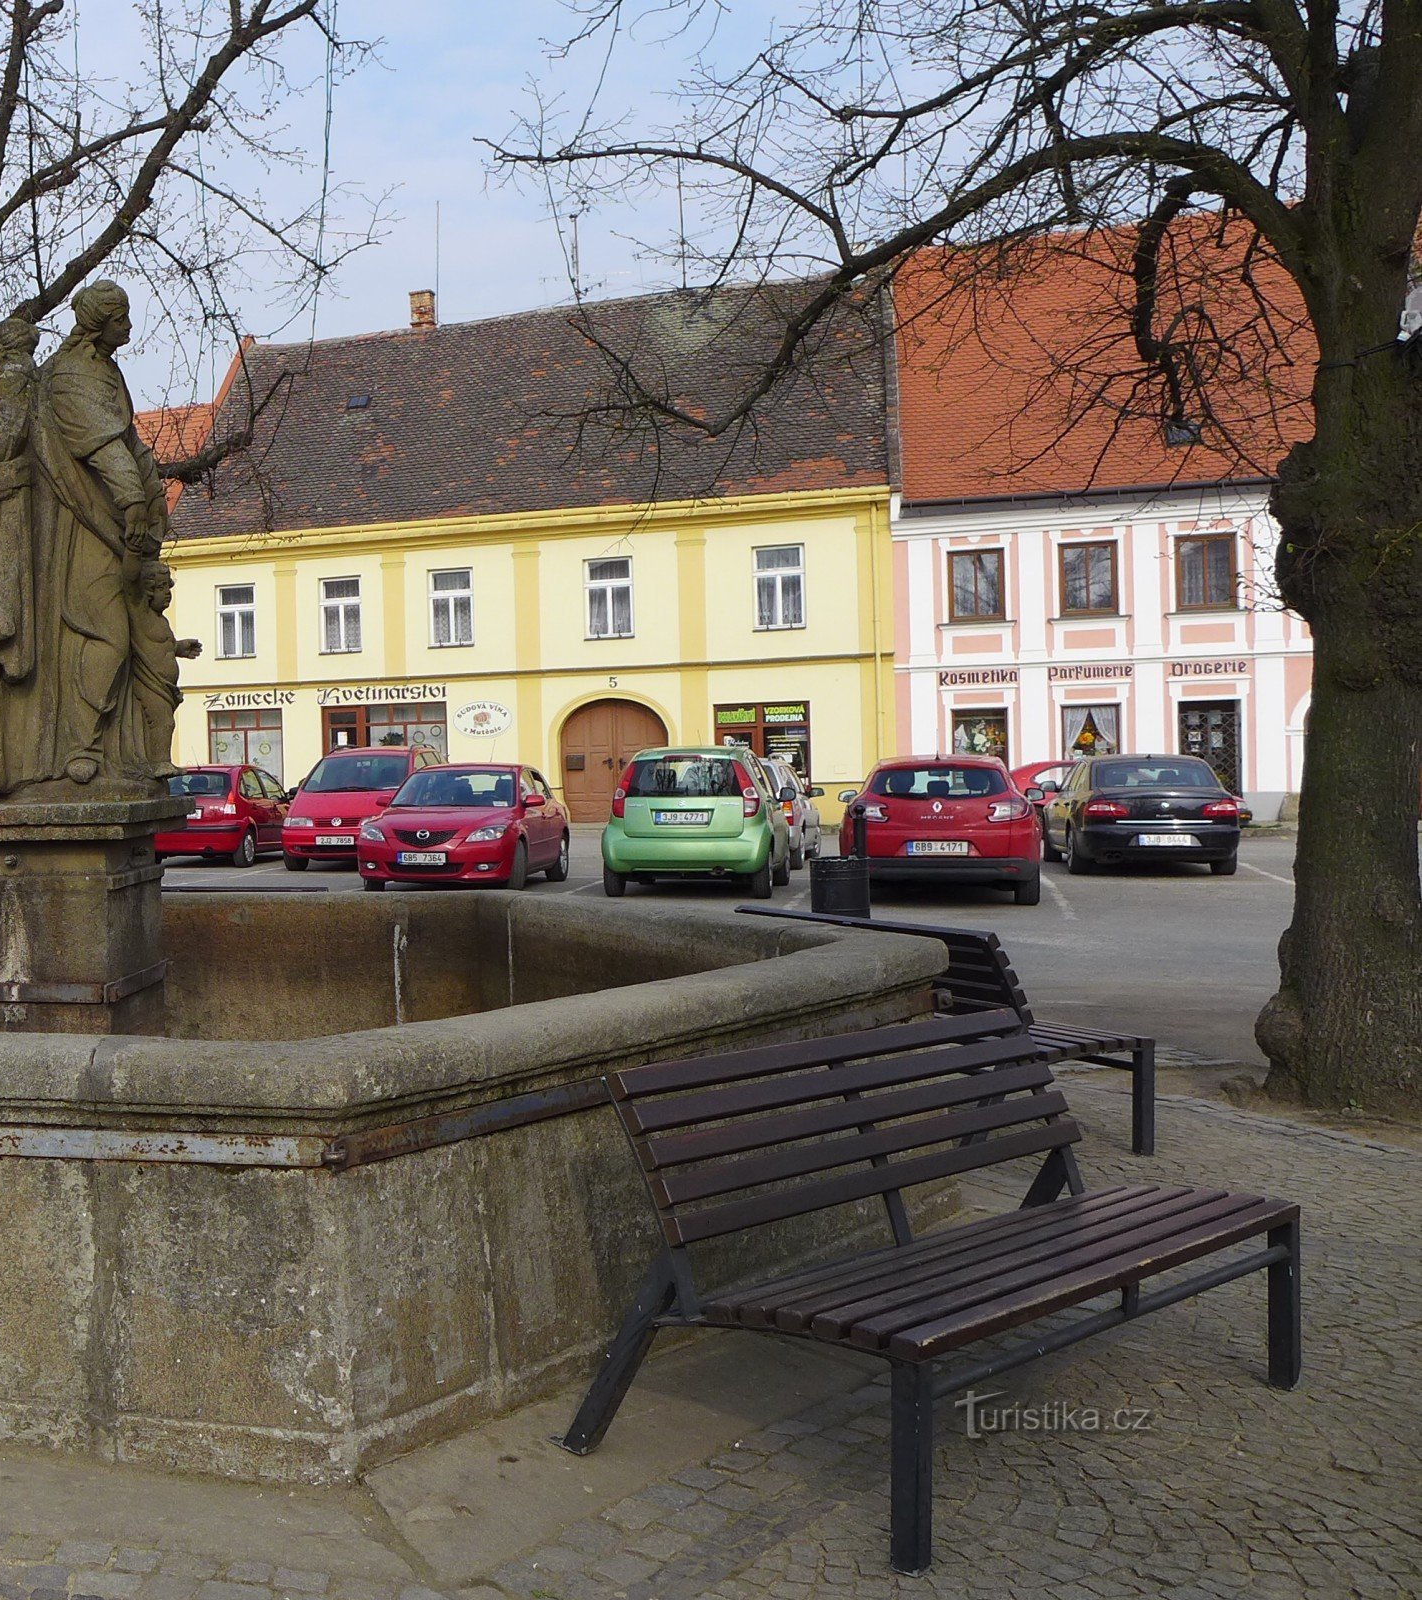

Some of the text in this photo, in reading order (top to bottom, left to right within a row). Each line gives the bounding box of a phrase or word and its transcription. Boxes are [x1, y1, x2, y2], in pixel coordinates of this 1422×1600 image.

[1048, 664, 1133, 682] Parfumerie
[1171, 661, 1247, 677] Drogerie
[609, 676, 618, 689] 5
[938, 668, 1018, 686] Kosmetika
[764, 703, 805, 715] VZORKOVÁ
[765, 714, 805, 723] PRODEJNA
[663, 812, 704, 821] 3J9 4771
[915, 841, 963, 852] 6B9 4171
[403, 854, 442, 863] 6B5 7364
